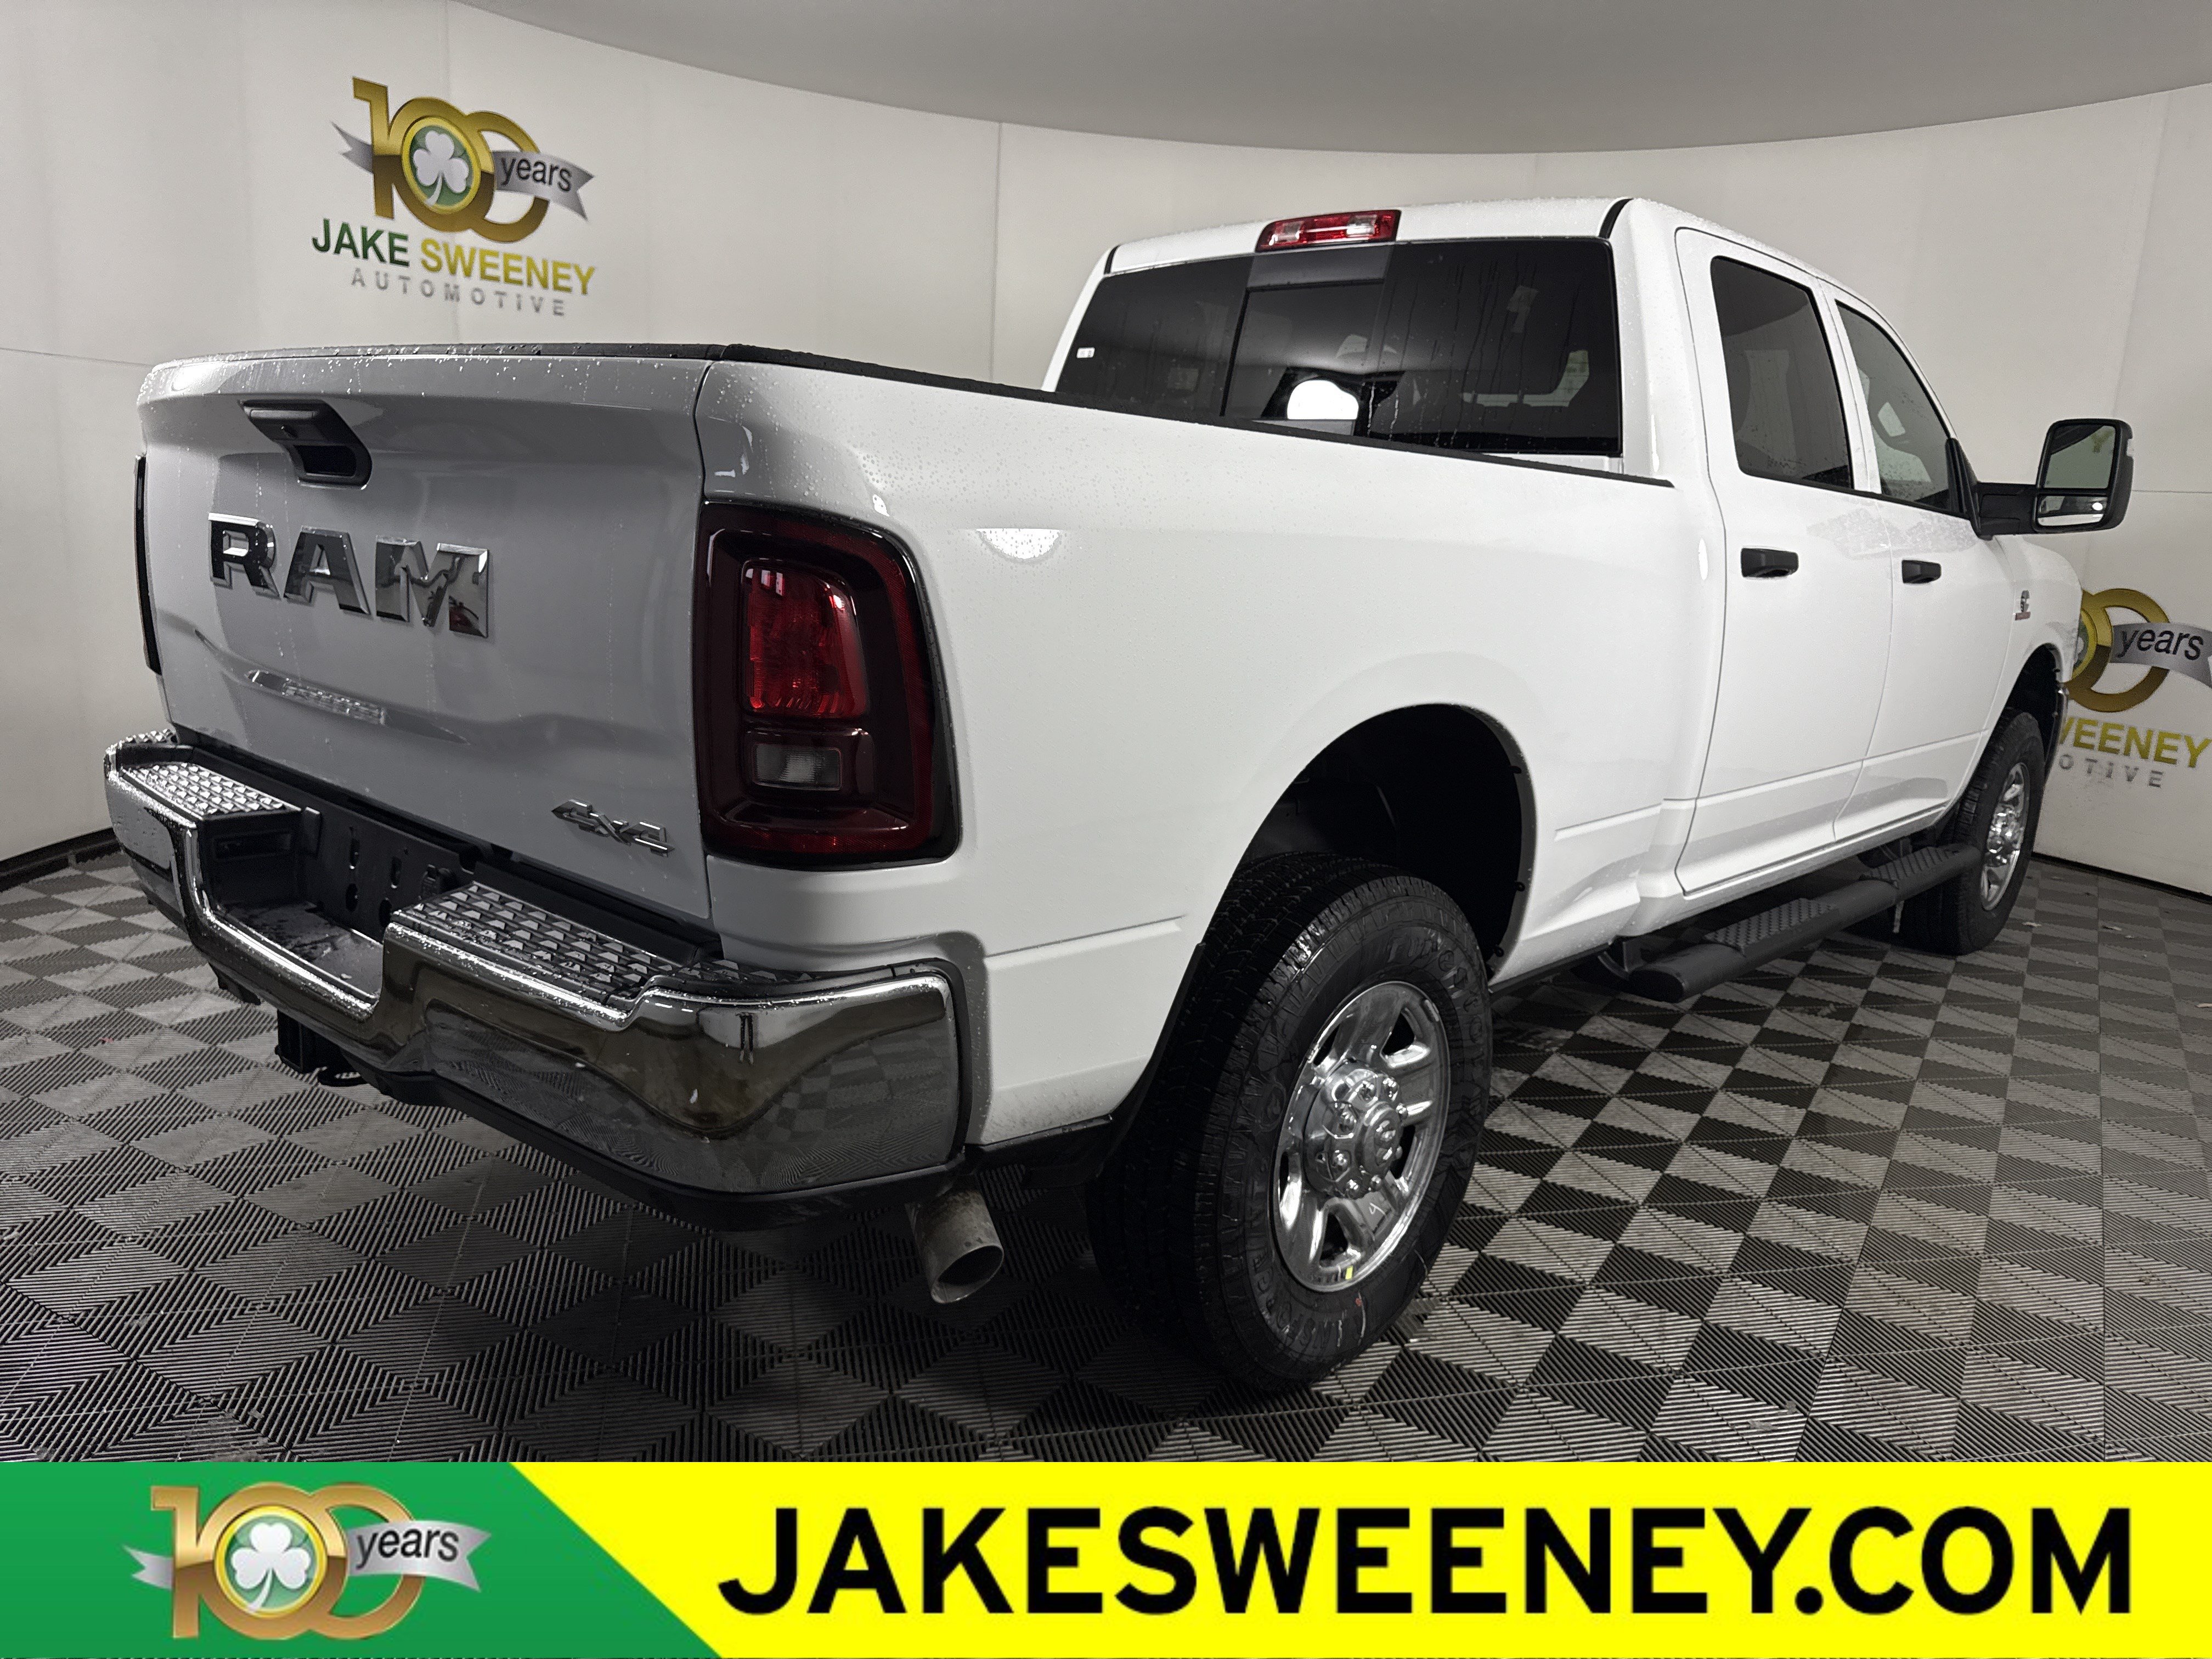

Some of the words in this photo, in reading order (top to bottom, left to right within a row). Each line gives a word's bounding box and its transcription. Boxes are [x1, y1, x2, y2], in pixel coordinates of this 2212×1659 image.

[501, 156, 573, 193] years
[312, 217, 410, 267] JAKE
[420, 238, 596, 295] SWEENEY
[351, 267, 566, 317] AUTOMOTIVE
[208, 512, 489, 639] RAM
[2117, 629, 2205, 662] years
[2059, 716, 2212, 769] EENEY
[2058, 754, 2164, 789] OTIVE
